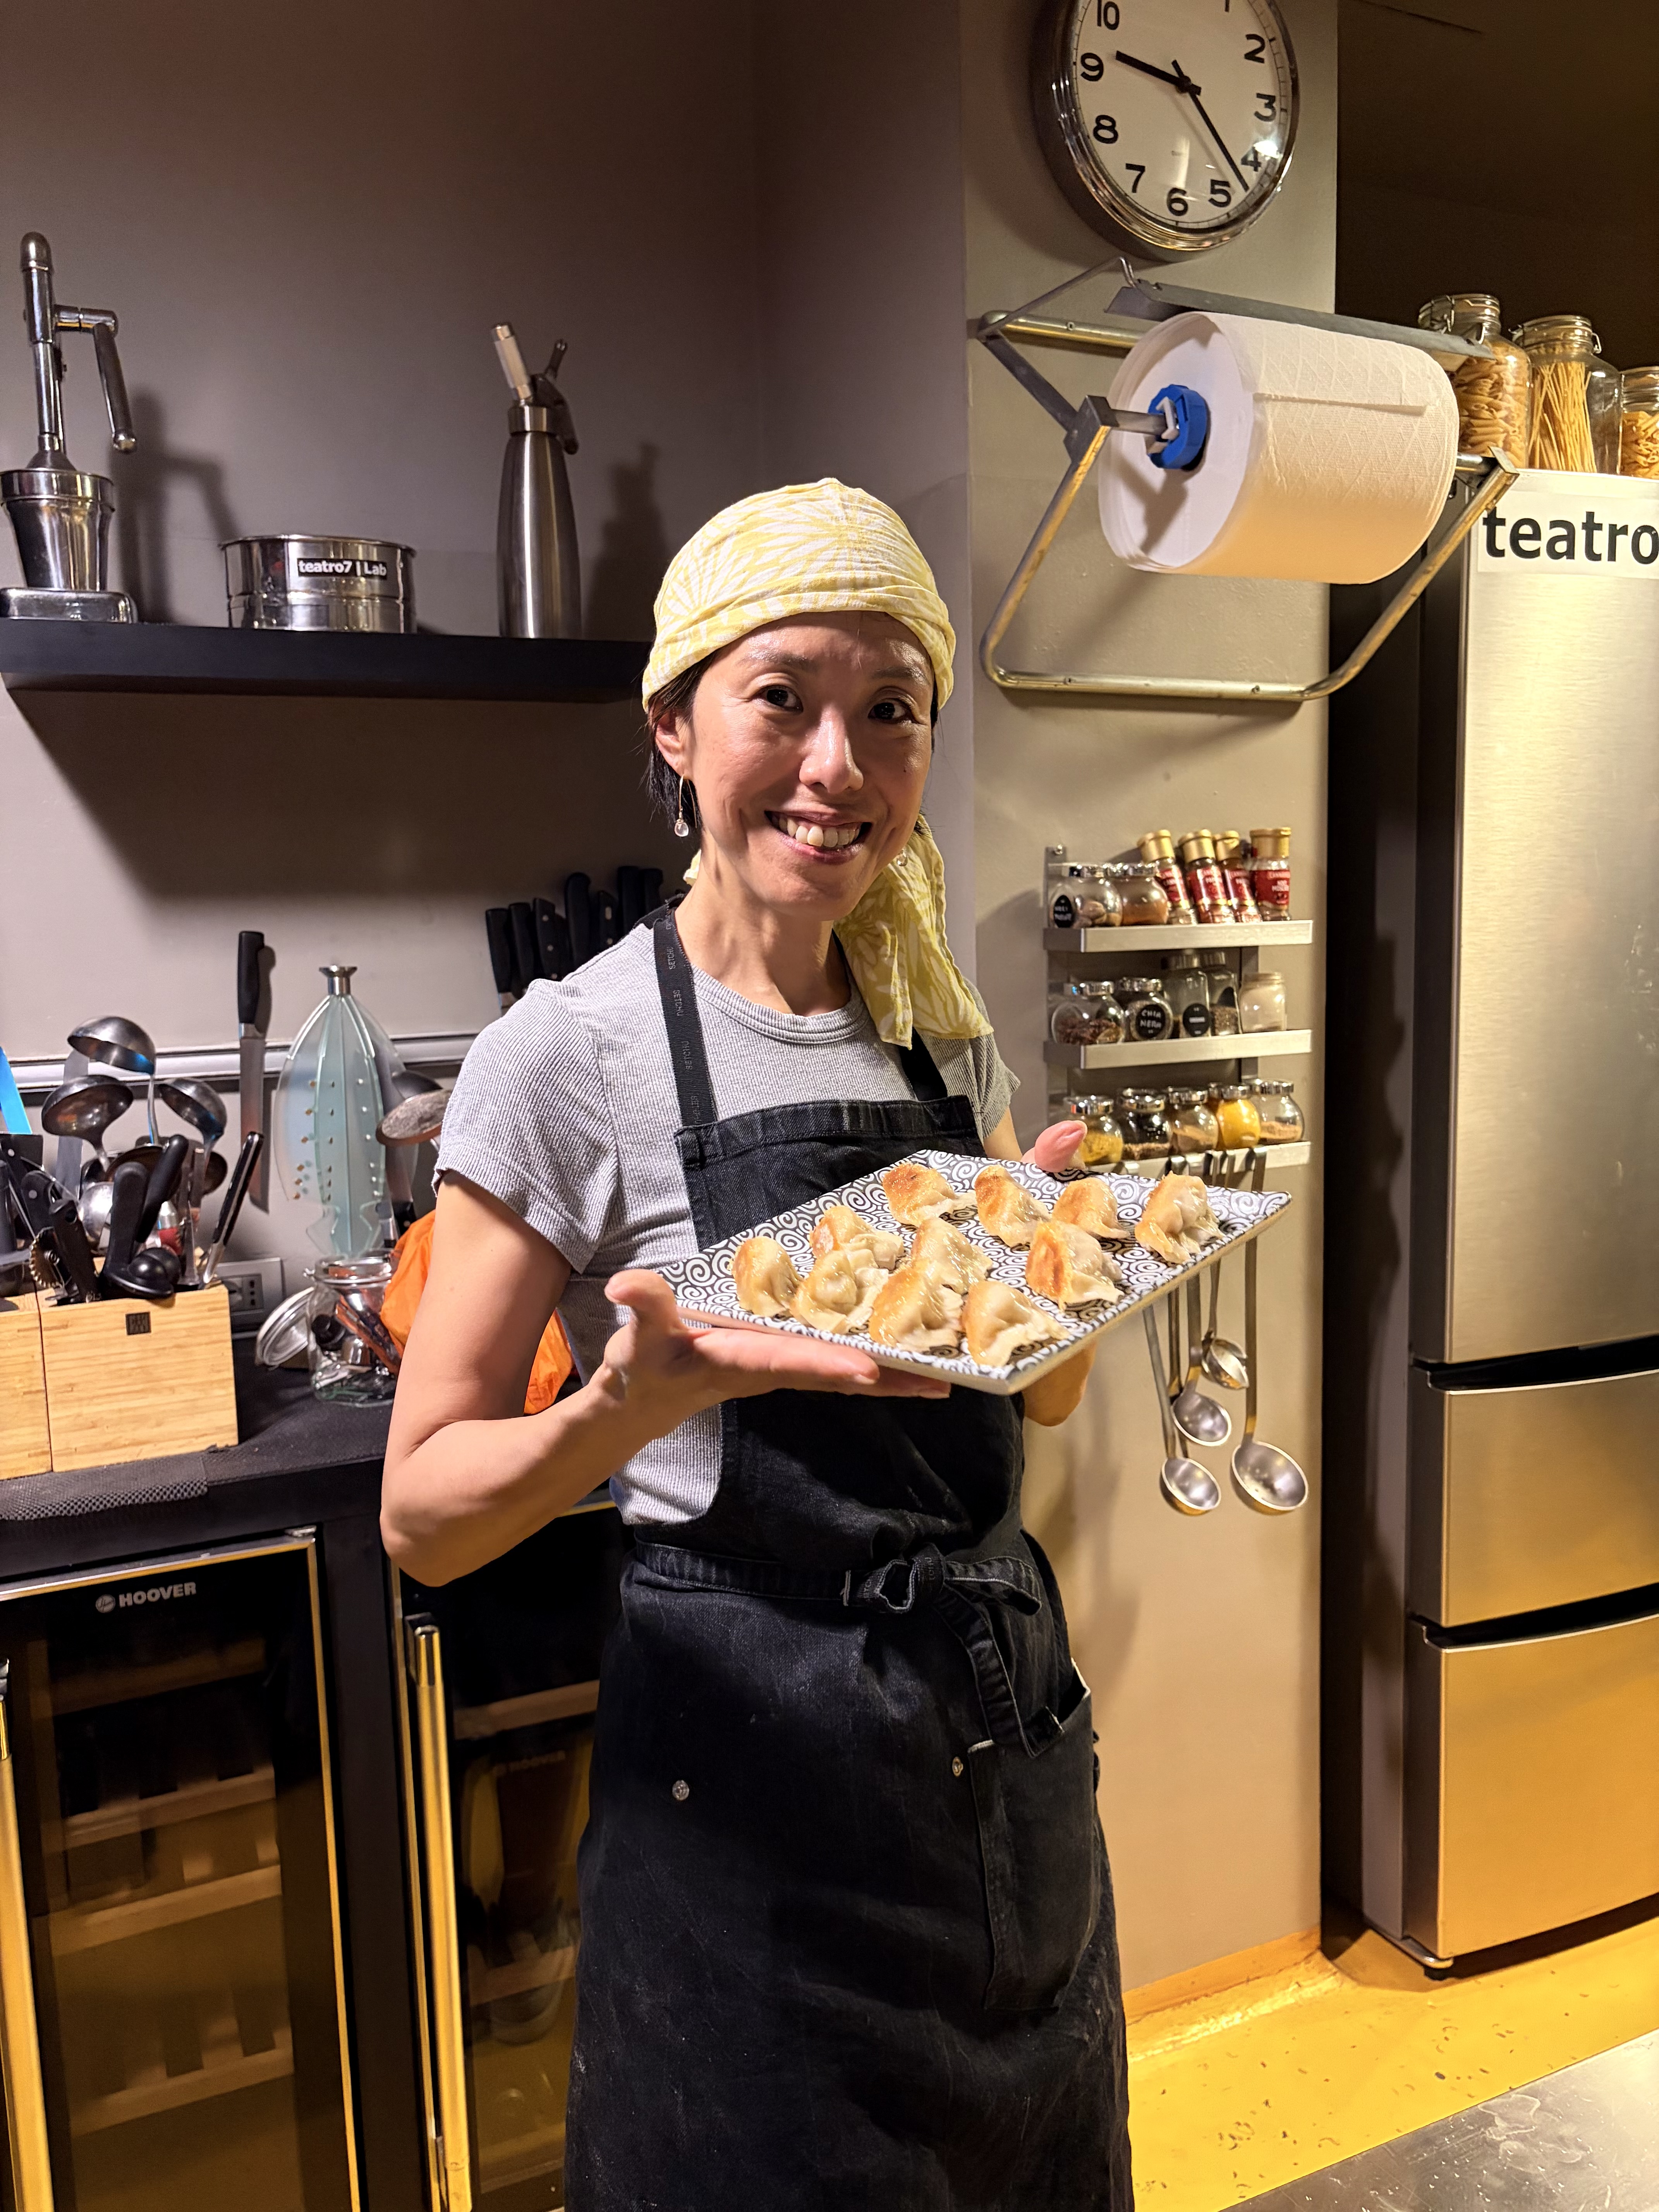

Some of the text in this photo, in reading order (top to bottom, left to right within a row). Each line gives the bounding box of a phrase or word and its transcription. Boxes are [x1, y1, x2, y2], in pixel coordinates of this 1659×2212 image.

[1097, 0, 1120, 30] 10
[1244, 34, 1266, 64] 2
[1080, 52, 1104, 82] 9
[1255, 93, 1276, 122] 3
[1093, 115, 1118, 144] 8
[1241, 146, 1262, 172] 4
[1125, 163, 1146, 193] 7
[1166, 187, 1188, 217] 6
[1209, 179, 1231, 208] 5
[1482, 506, 1659, 565] teatro
[298, 559, 352, 574] teatro7
[364, 563, 387, 576] Lab
[666, 946, 676, 970] SETCHU
[119, 1582, 196, 1608] HOOVER
